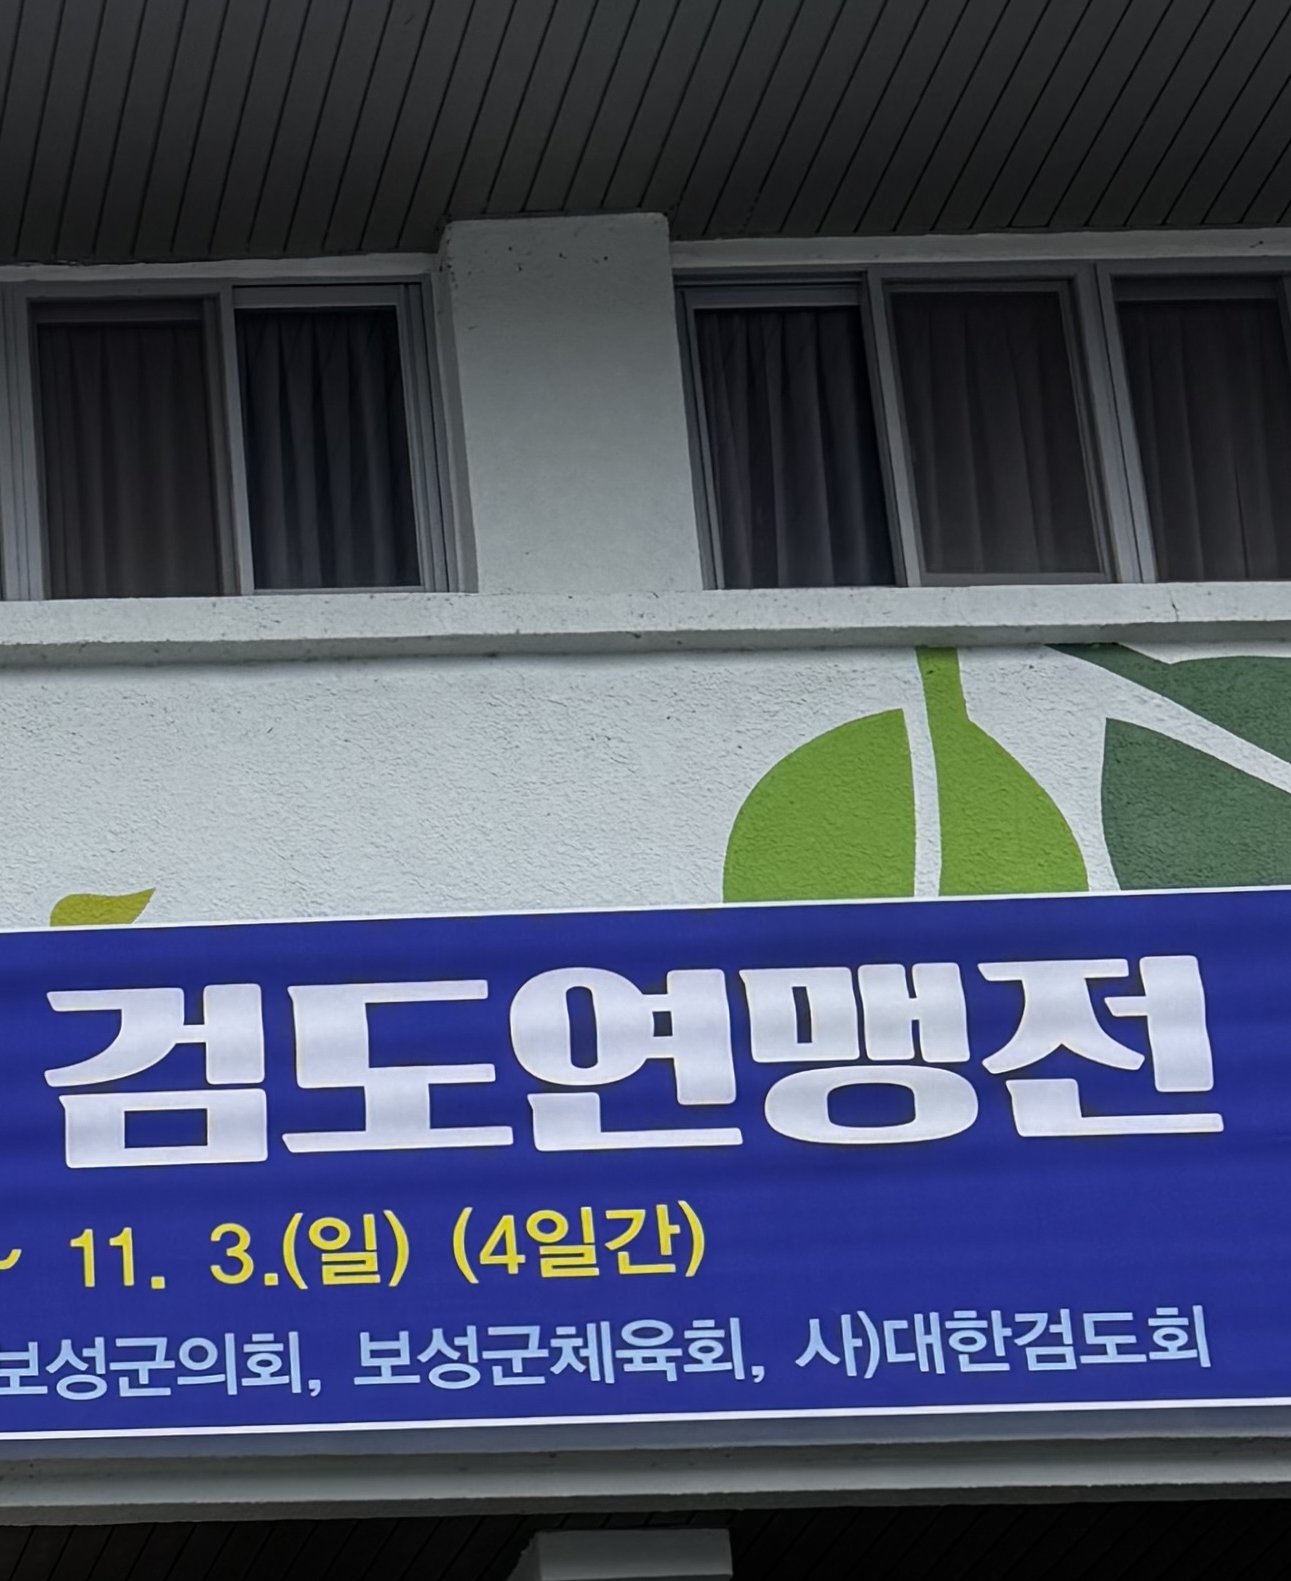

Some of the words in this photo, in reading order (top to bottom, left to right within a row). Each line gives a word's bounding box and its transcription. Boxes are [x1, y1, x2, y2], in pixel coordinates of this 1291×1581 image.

[43, 954, 1225, 1169] 검도연맹전
[69, 1226, 166, 1290] 11.
[210, 1209, 410, 1290] 3.(일)
[452, 1199, 706, 1285] (4일간)
[353, 1317, 765, 1390] 보성군체육회,
[795, 1304, 1211, 1379] 사)대한검도회
